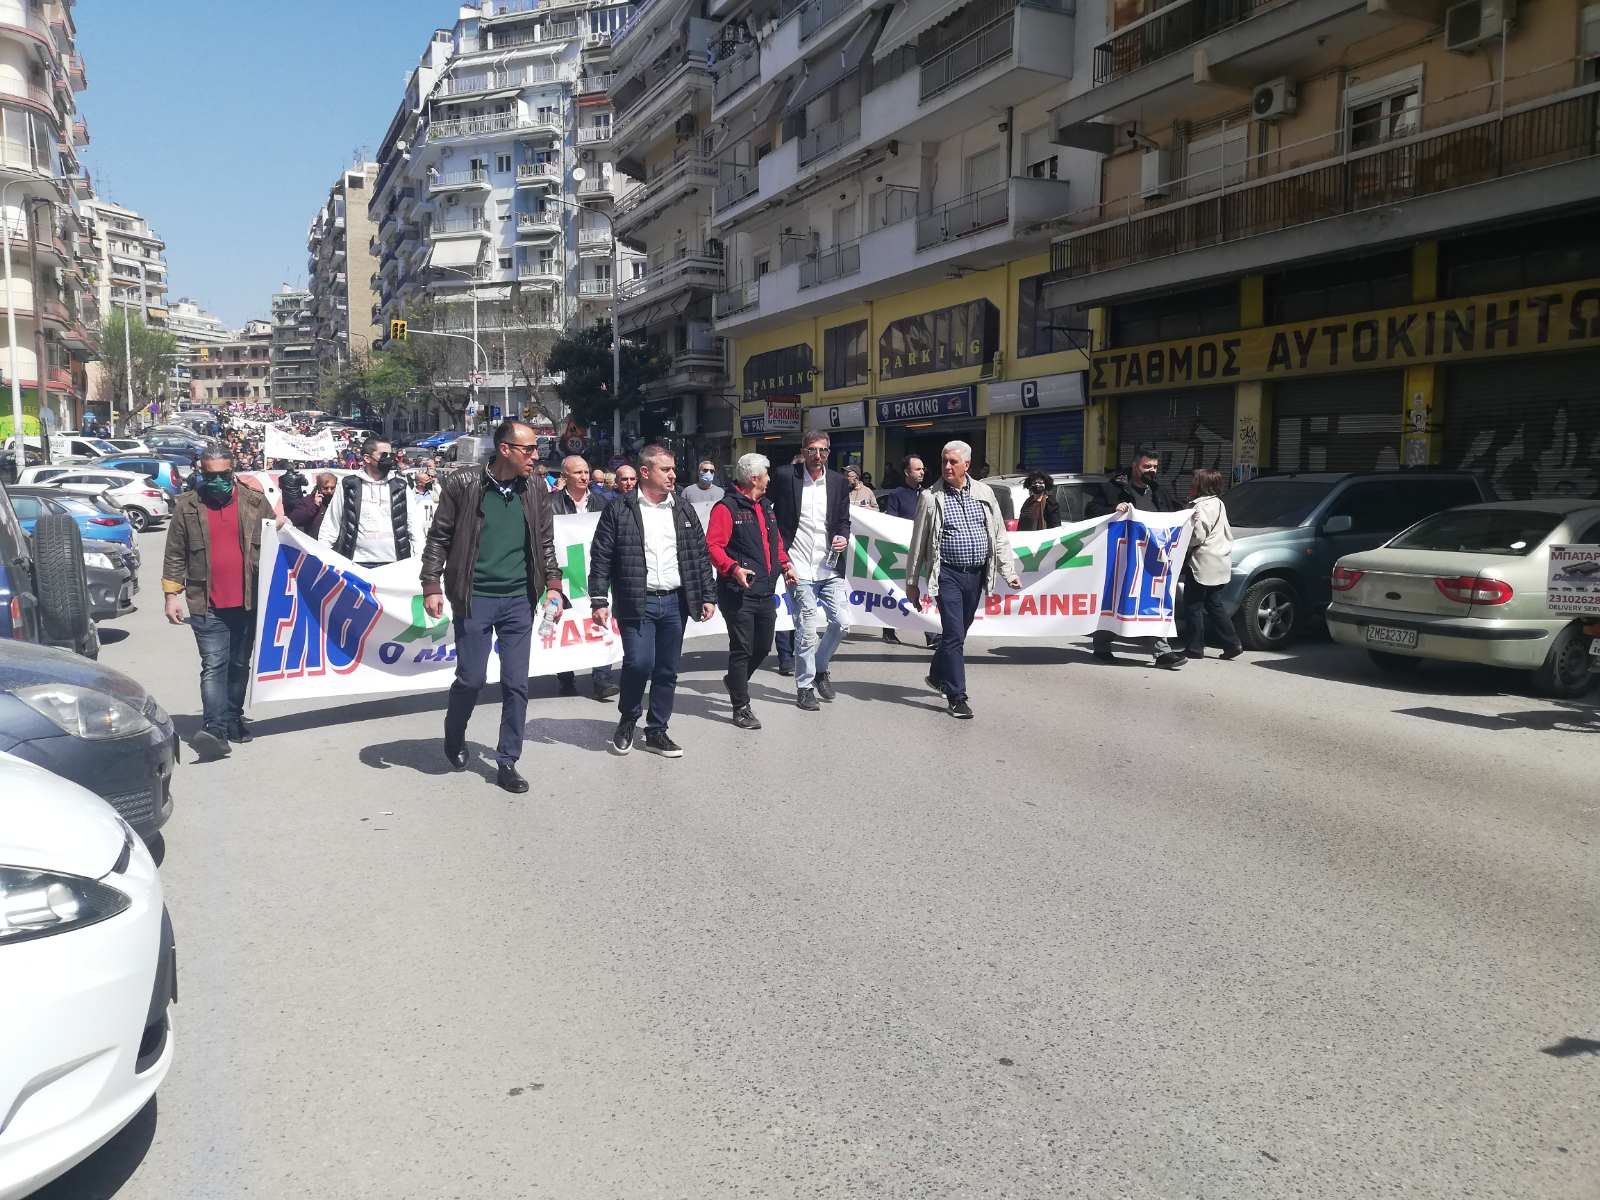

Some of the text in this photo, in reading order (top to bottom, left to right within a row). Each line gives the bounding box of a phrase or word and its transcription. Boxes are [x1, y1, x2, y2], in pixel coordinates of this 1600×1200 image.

[881, 339, 981, 369] PARKING
[1092, 338, 1241, 390] ΣΤΑΘΜΟΣ
[753, 369, 813, 392] PARKING
[768, 407, 800, 420] PARKING
[894, 398, 939, 417] PARKING
[752, 419, 766, 433] PAR
